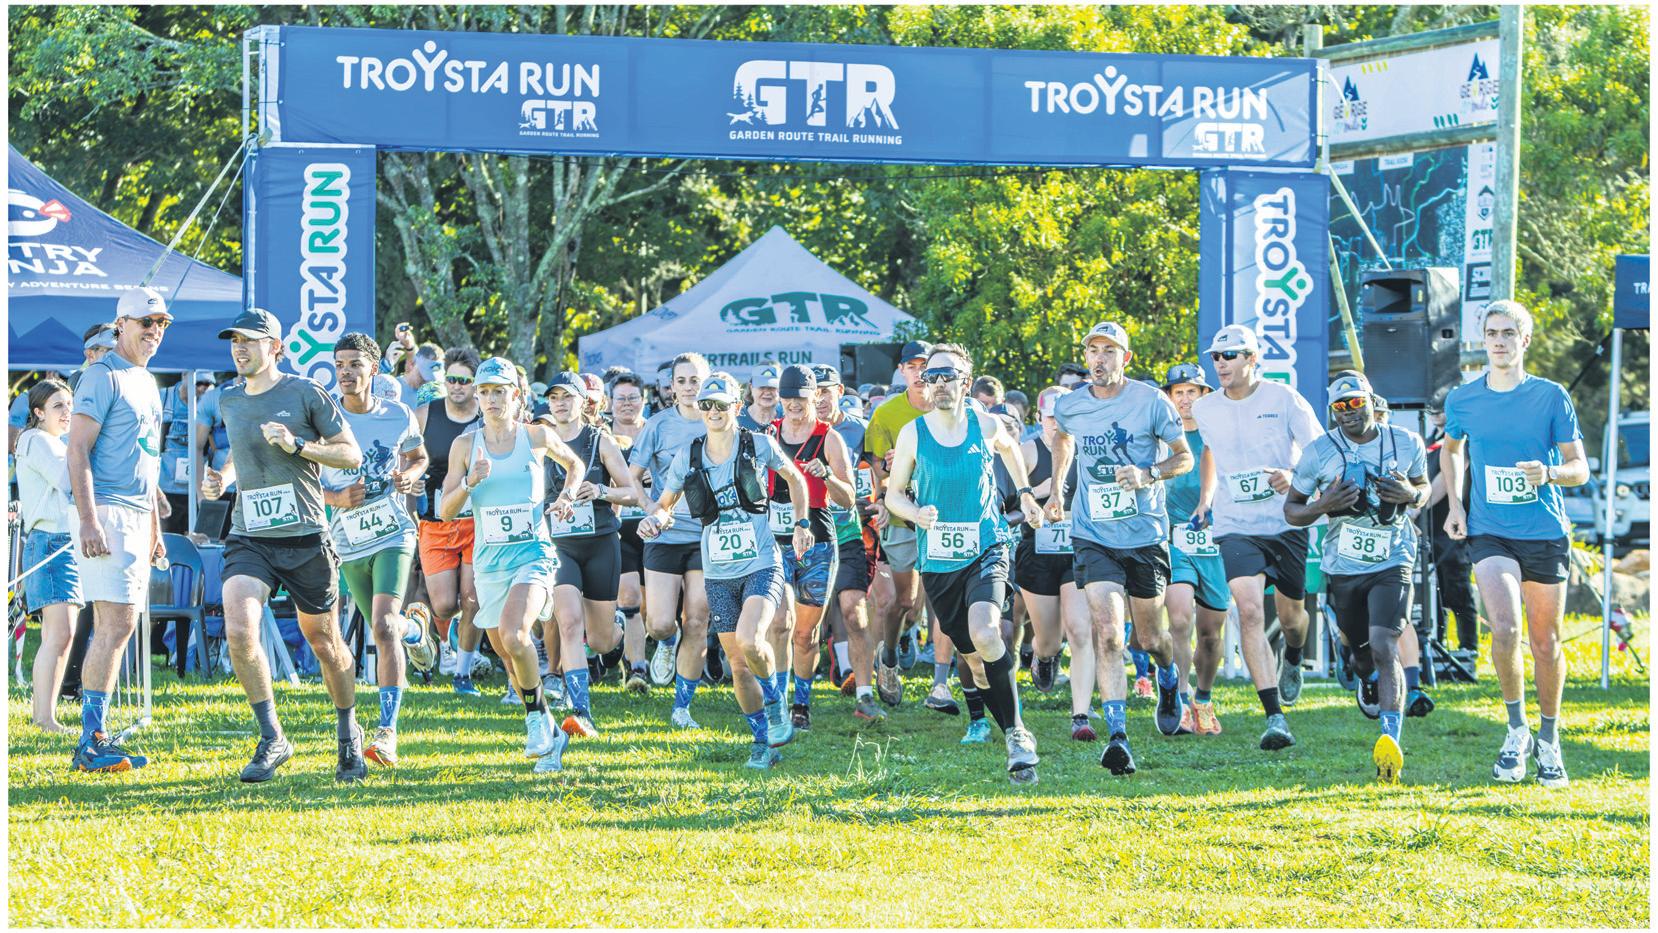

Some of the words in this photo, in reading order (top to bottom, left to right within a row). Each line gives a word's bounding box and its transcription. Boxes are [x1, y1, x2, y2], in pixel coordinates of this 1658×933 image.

[336, 40, 509, 94] TROYSTA
[519, 61, 600, 98] RUN
[732, 59, 900, 130] GTR
[1024, 65, 1184, 118] TROYSTA
[1192, 85, 1268, 121] RUN
[519, 99, 599, 131] GTR
[729, 130, 774, 140] GARDEN
[778, 132, 815, 141] ROUTE
[818, 132, 850, 143] TRAIL
[852, 134, 903, 145] RUNNING
[1193, 122, 1265, 152] GTR
[308, 170, 344, 253] RUN
[8, 242, 104, 263] TRY
[20, 281, 111, 290] ADVENTURE
[1262, 194, 1307, 361] TROYSTA
[719, 291, 879, 329] GTR
[779, 351, 812, 365] RUN
[1083, 445, 1107, 456] RUN
[1240, 477, 1258, 493] 67
[1496, 476, 1526, 493] 103
[252, 496, 282, 518] 107
[1101, 491, 1121, 509] 37
[359, 512, 383, 531] 44
[500, 515, 513, 532] 9
[776, 511, 792, 525] 15
[719, 533, 742, 551] 20
[941, 532, 965, 549] 56
[1051, 529, 1066, 543] 71
[1186, 531, 1207, 545] 98
[1352, 536, 1376, 553] 38
